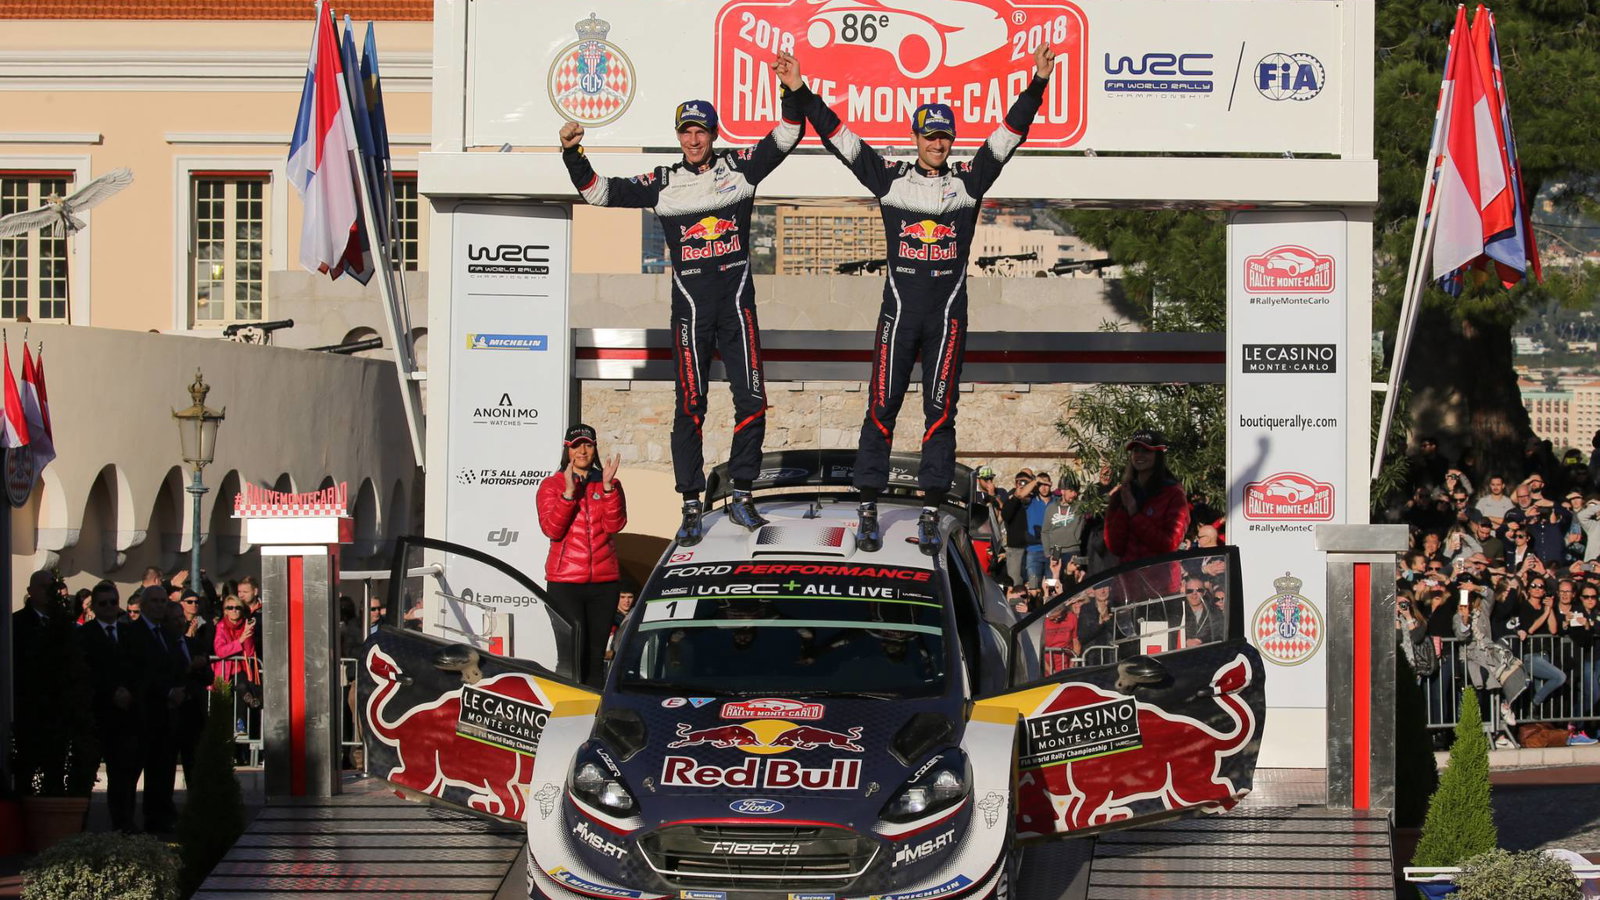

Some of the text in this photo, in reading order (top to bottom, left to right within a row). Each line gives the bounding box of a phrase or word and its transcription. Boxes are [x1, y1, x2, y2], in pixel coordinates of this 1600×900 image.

[739, 12, 795, 56] 2018
[1011, 15, 1068, 61] 2018
[1105, 53, 1213, 75] WRC
[468, 244, 550, 262] WRC
[681, 234, 741, 261] Red Bull
[898, 241, 957, 261] Red Bull
[1249, 268, 1274, 287] RALLYE
[1250, 297, 1330, 306] #RallyeMonteCarlo
[681, 323, 689, 346] FORD
[882, 321, 891, 343] FORD
[489, 339, 541, 347] MICHELIN
[1245, 347, 1333, 361] LE CASINO
[752, 370, 761, 393] FORD
[935, 380, 946, 403] FORD
[473, 408, 538, 418] ANONIMO
[1240, 414, 1337, 431] boutiquerallye.com
[1249, 496, 1274, 514] RALLYE
[1249, 525, 1313, 533] #RallyeMonteC
[664, 565, 931, 582] FORD PERFORMANCE
[476, 593, 538, 607] tamaggo
[803, 584, 842, 595] ALL
[848, 586, 893, 598] LIVE
[665, 601, 678, 618] 1
[464, 691, 549, 729] LE CASINO
[726, 707, 754, 716] RALLYE
[1031, 704, 1133, 739] LE CASINO
[487, 733, 502, 742] World
[503, 737, 516, 747] Rally
[1051, 751, 1066, 761] Rally
[1067, 744, 1108, 757] Championship
[660, 756, 862, 790] Red Bull
[738, 801, 775, 813] Ford
[711, 842, 799, 855] Fiesta
[568, 878, 631, 897] MICHELIN
[898, 881, 960, 900] MICHELIN
